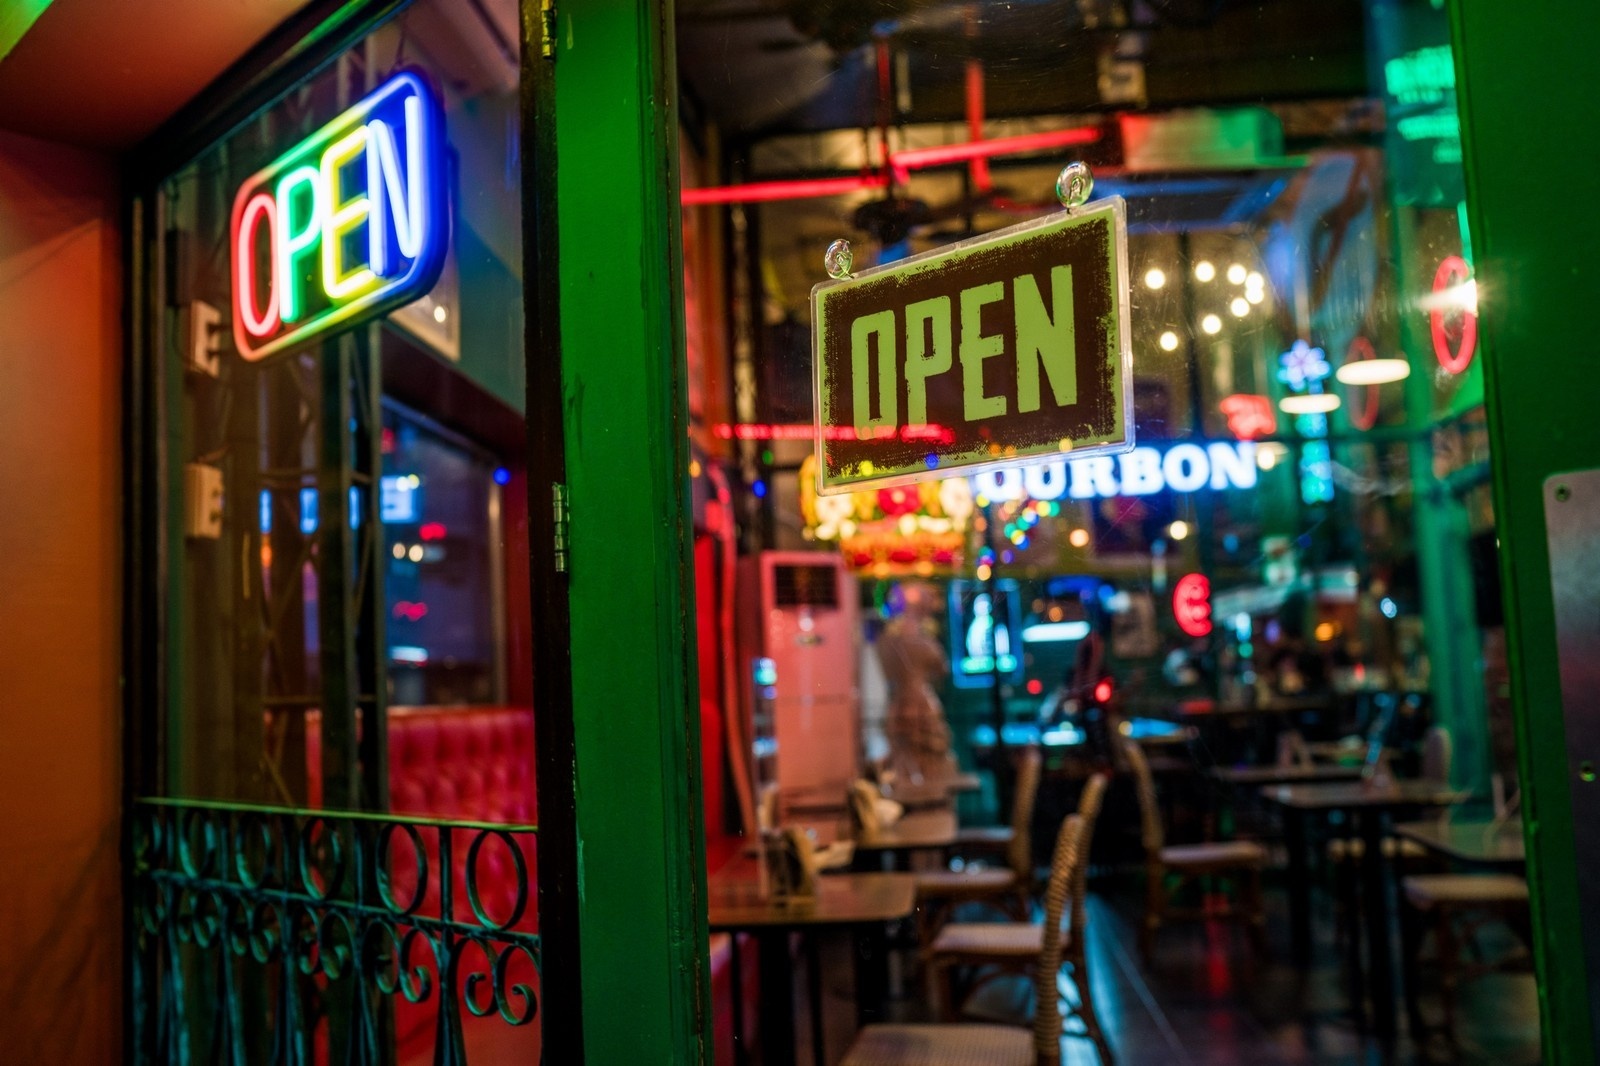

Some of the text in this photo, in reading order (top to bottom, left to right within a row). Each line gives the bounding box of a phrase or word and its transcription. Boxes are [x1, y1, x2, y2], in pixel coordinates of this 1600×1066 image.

[238, 95, 422, 337] OPEN
[851, 264, 1078, 440] OPEN
[970, 440, 1258, 503] OURBON
